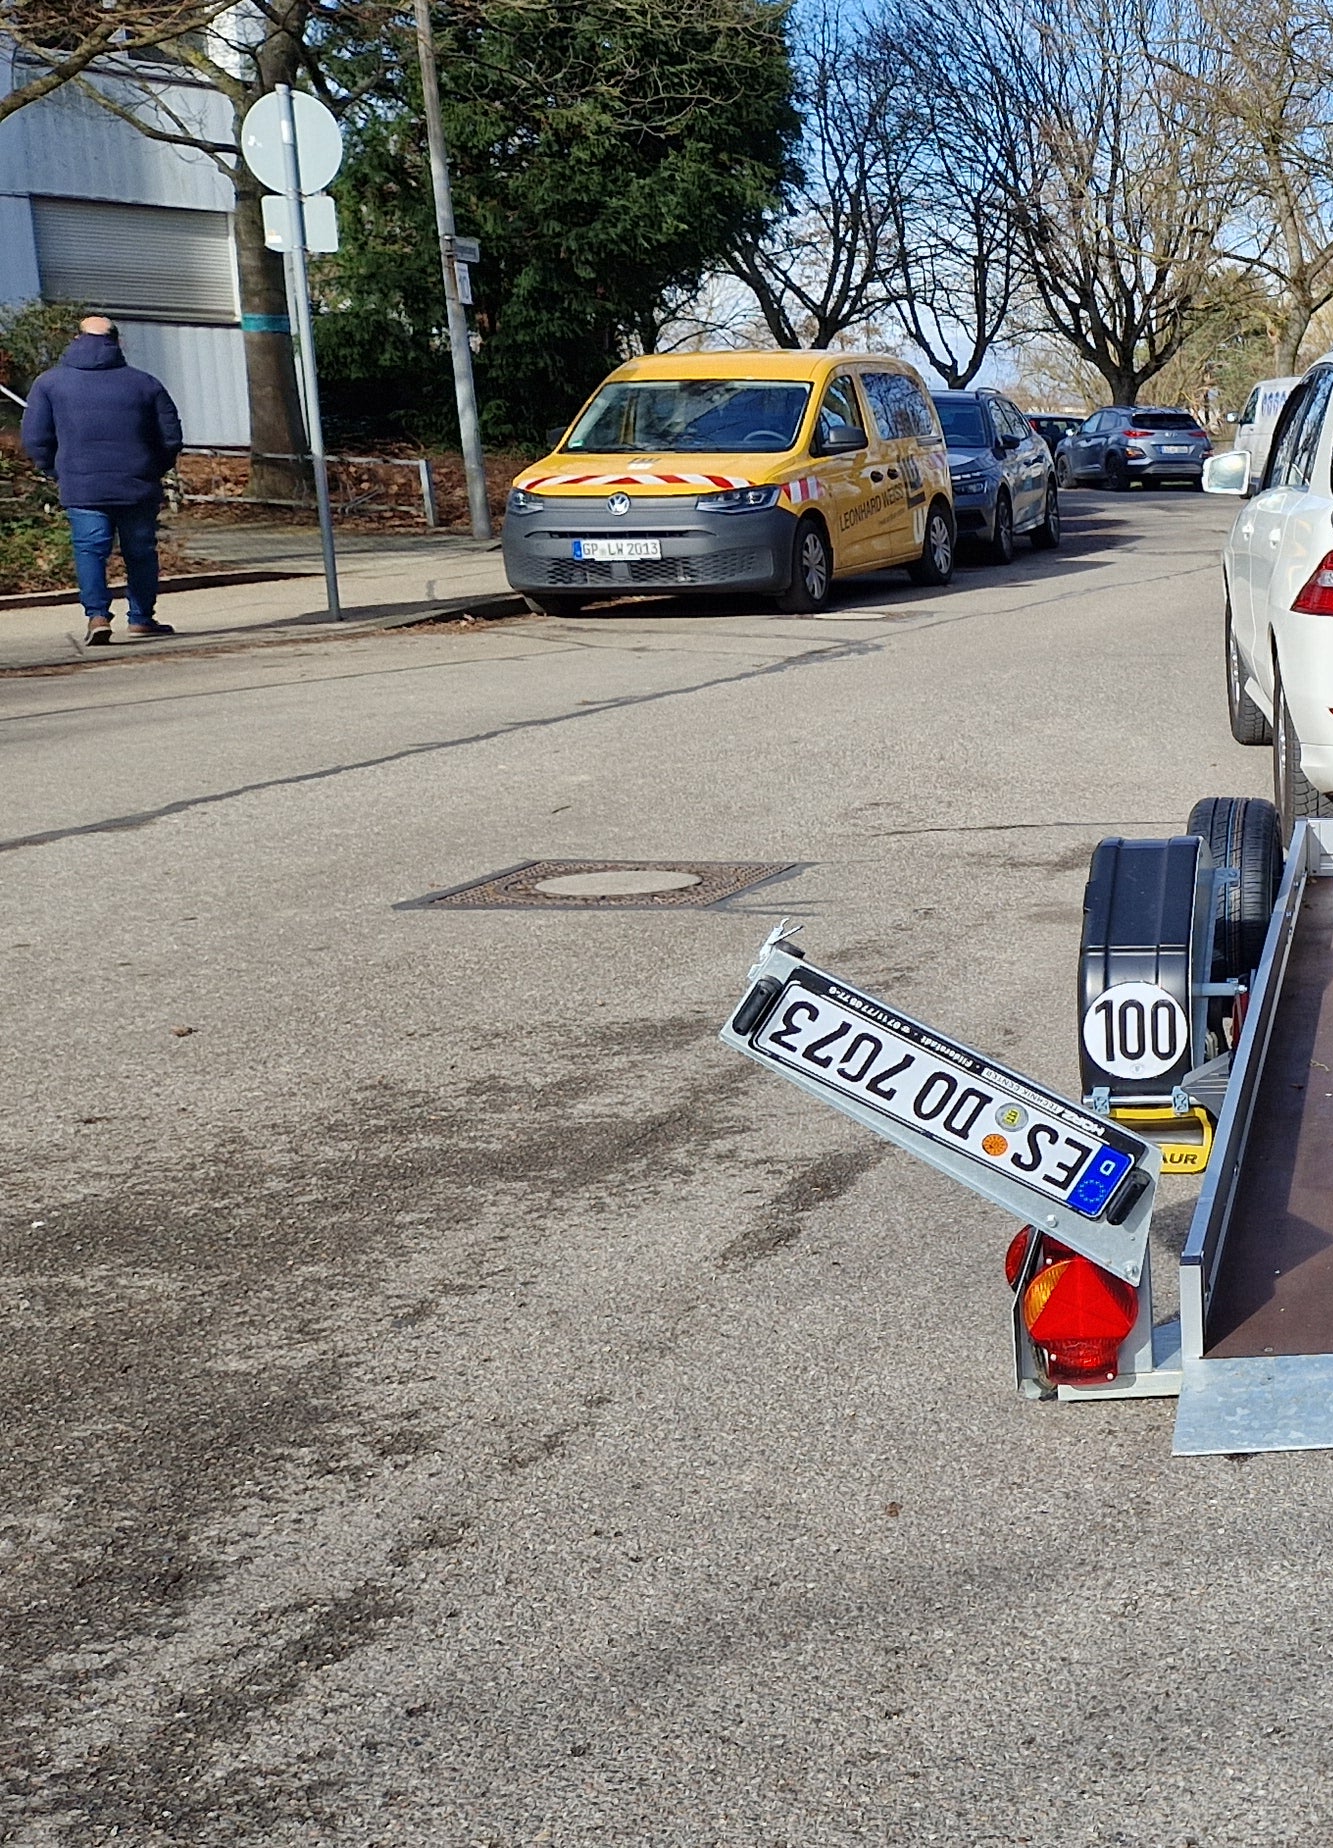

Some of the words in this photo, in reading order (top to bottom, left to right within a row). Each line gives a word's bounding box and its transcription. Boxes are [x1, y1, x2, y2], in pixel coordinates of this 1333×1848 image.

[840, 496, 881, 532] LEONHARD
[583, 543, 598, 555] GP
[627, 543, 658, 555] 2013
[769, 999, 916, 1101] 7073
[1095, 999, 1177, 1061] 100
[1012, 1123, 1093, 1191] ES
